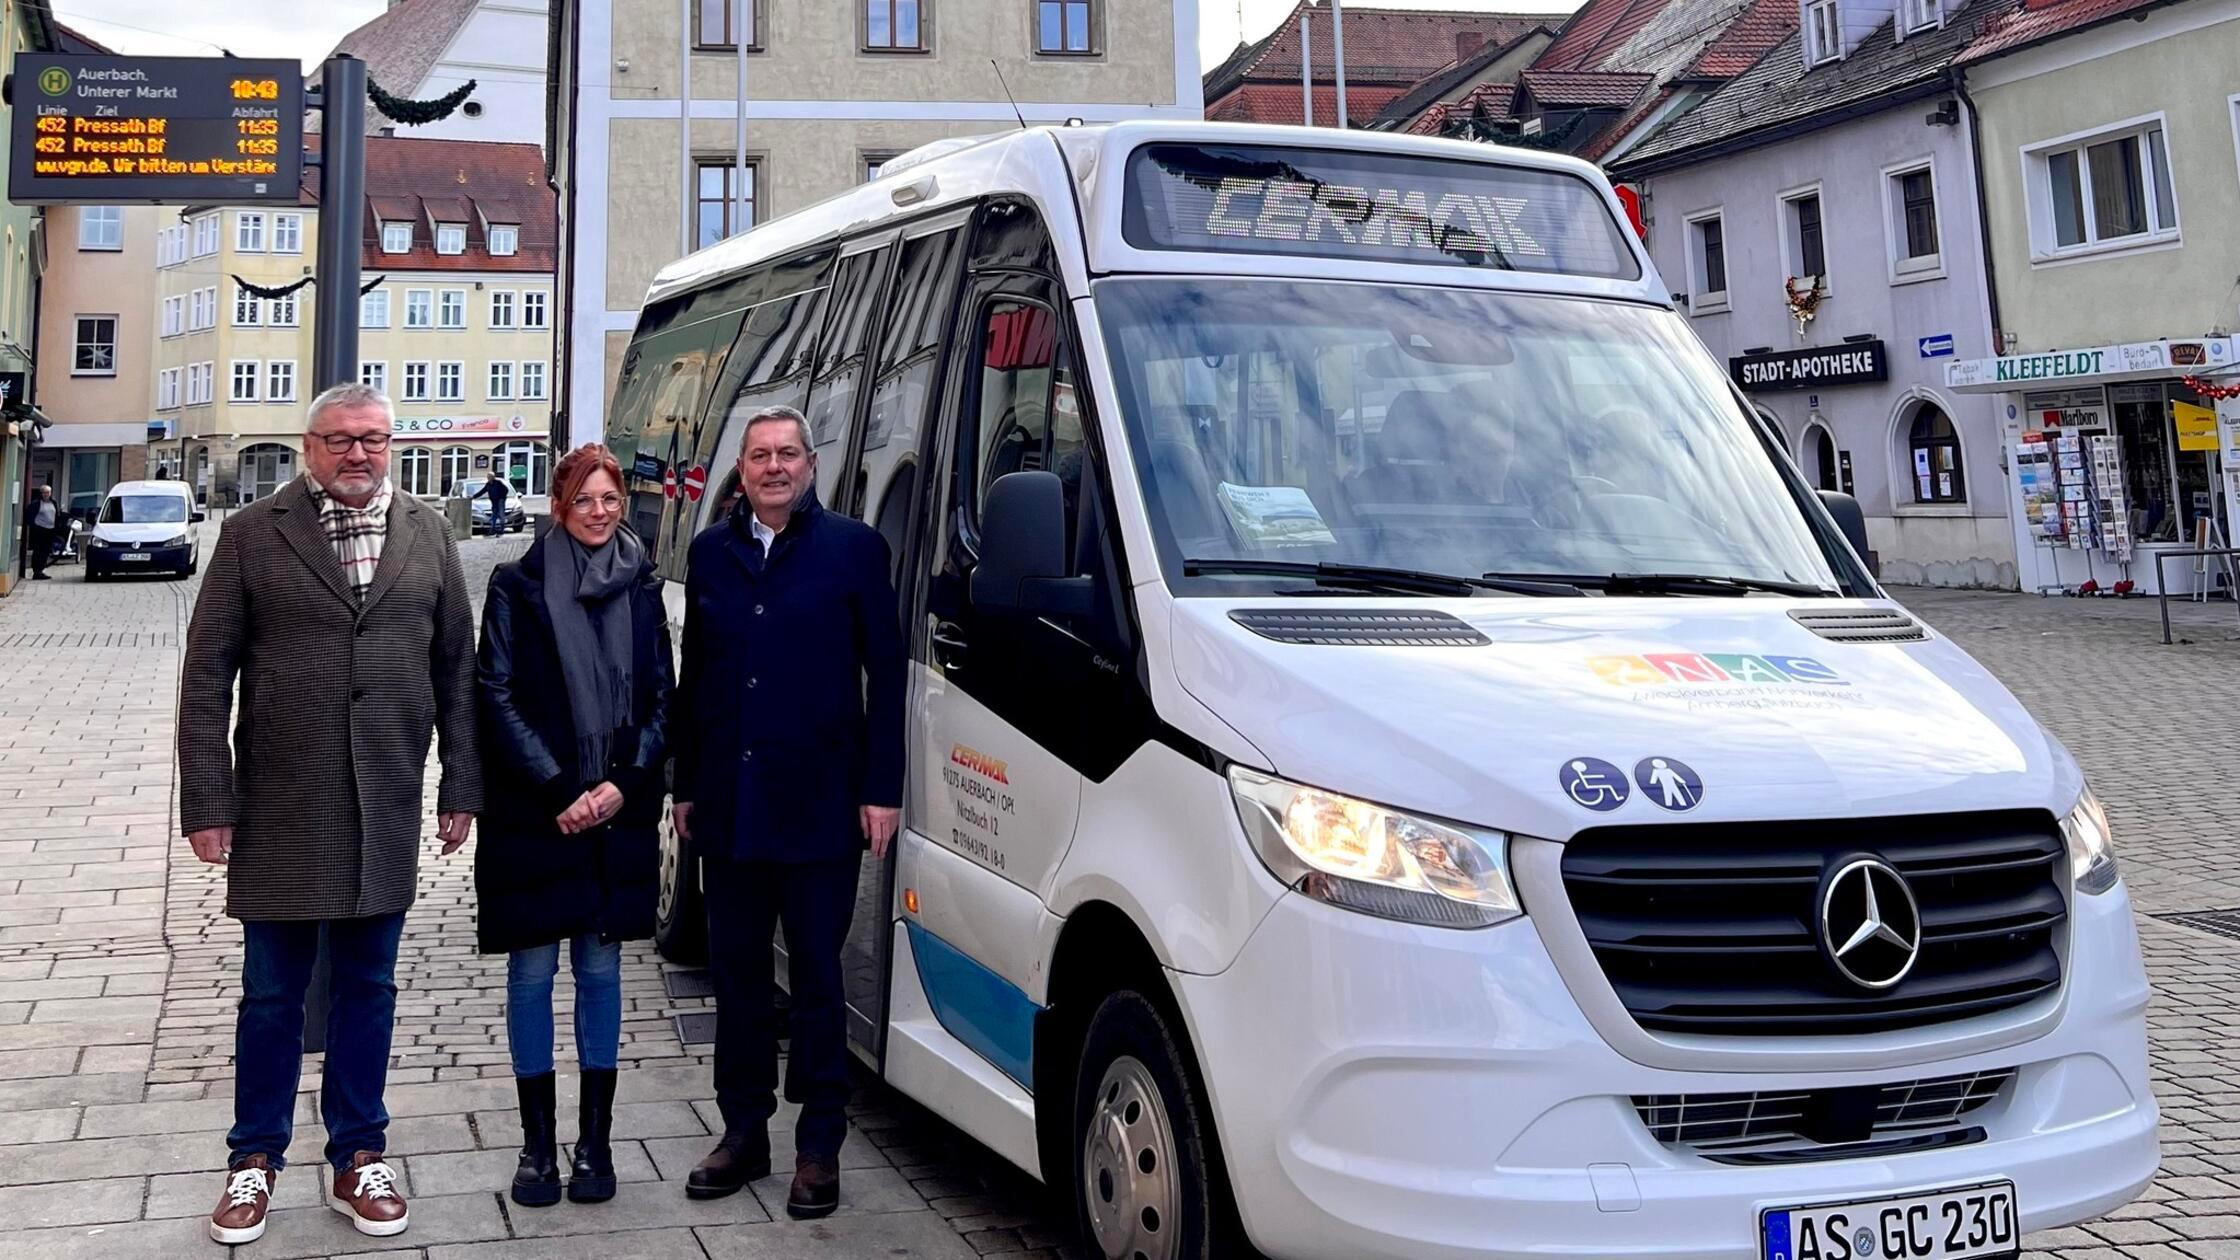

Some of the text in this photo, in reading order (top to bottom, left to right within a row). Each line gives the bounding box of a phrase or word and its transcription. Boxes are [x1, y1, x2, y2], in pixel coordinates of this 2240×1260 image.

[47, 73, 64, 90] H
[230, 80, 279, 99] 10:43
[77, 85, 178, 98] Unterer Markt
[37, 105, 279, 118] Linie Ziel Abfahrt
[37, 117, 279, 135] 452 Pressath Bf 11:35
[35, 138, 279, 155] 452 Pressath Bf 11:35
[139, 158, 187, 173] bitten
[1205, 176, 1547, 256] CERMAK
[1743, 351, 1874, 384] STADT-APOTHEKE
[1996, 351, 2104, 381] KLEEFELDT
[2128, 358, 2159, 370] bedarf
[426, 419, 453, 431] CO
[2059, 408, 2099, 427] Marlboro
[951, 741, 1010, 785] CERMAK
[943, 766, 960, 790] 91275
[960, 777, 996, 807] AUERBACH
[990, 817, 999, 836] 12
[1798, 1193, 2012, 1260] AS GC 230
